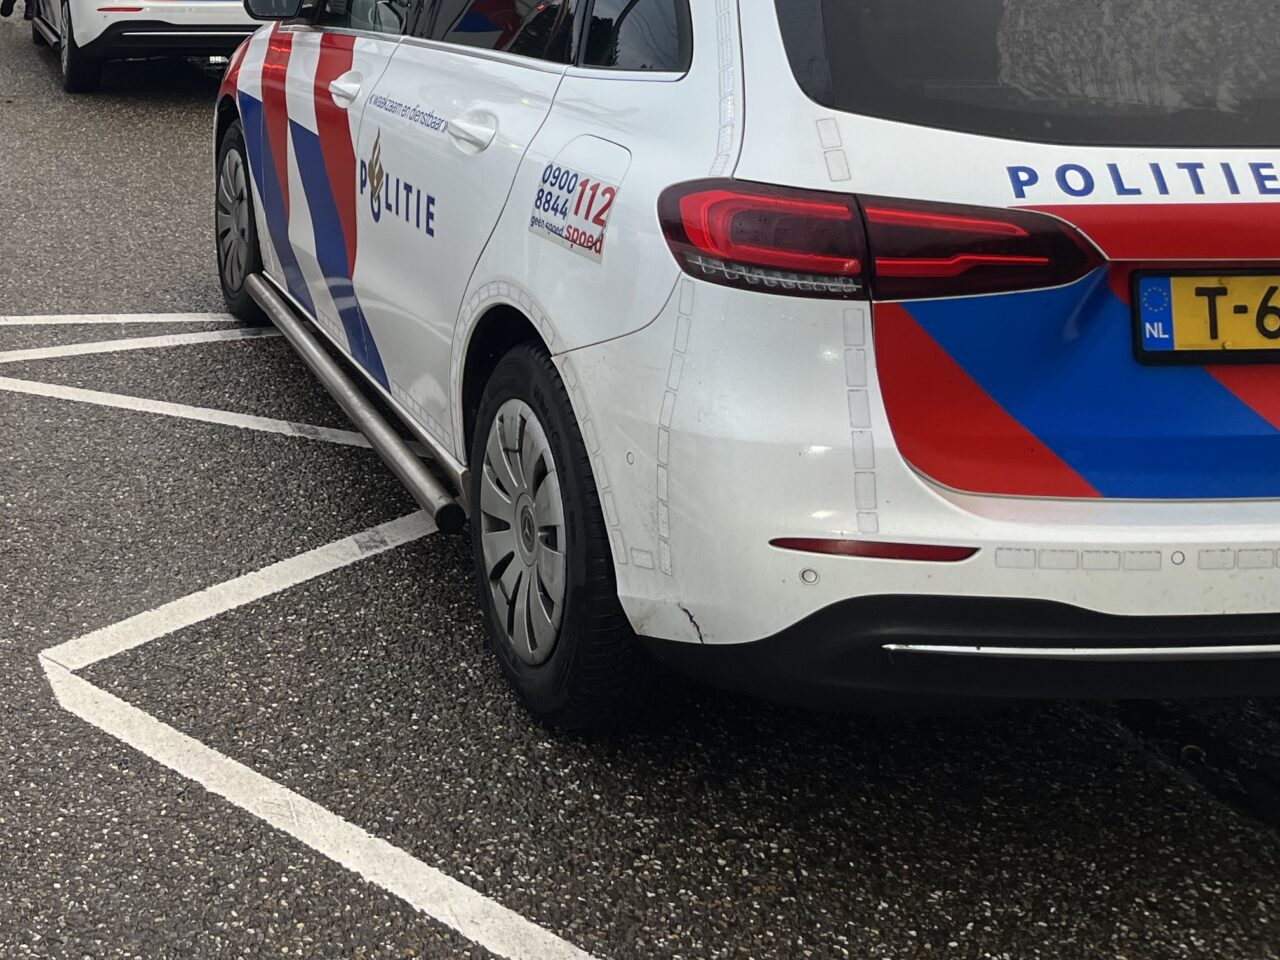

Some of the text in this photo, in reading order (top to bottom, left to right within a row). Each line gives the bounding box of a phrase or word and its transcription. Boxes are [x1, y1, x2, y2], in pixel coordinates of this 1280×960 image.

[541, 163, 579, 194] 0900
[1005, 162, 1280, 199] POLITIE
[534, 188, 569, 220] 8844
[574, 177, 616, 228] 112
[565, 224, 604, 256] spoed
[1145, 322, 1169, 339] NL
